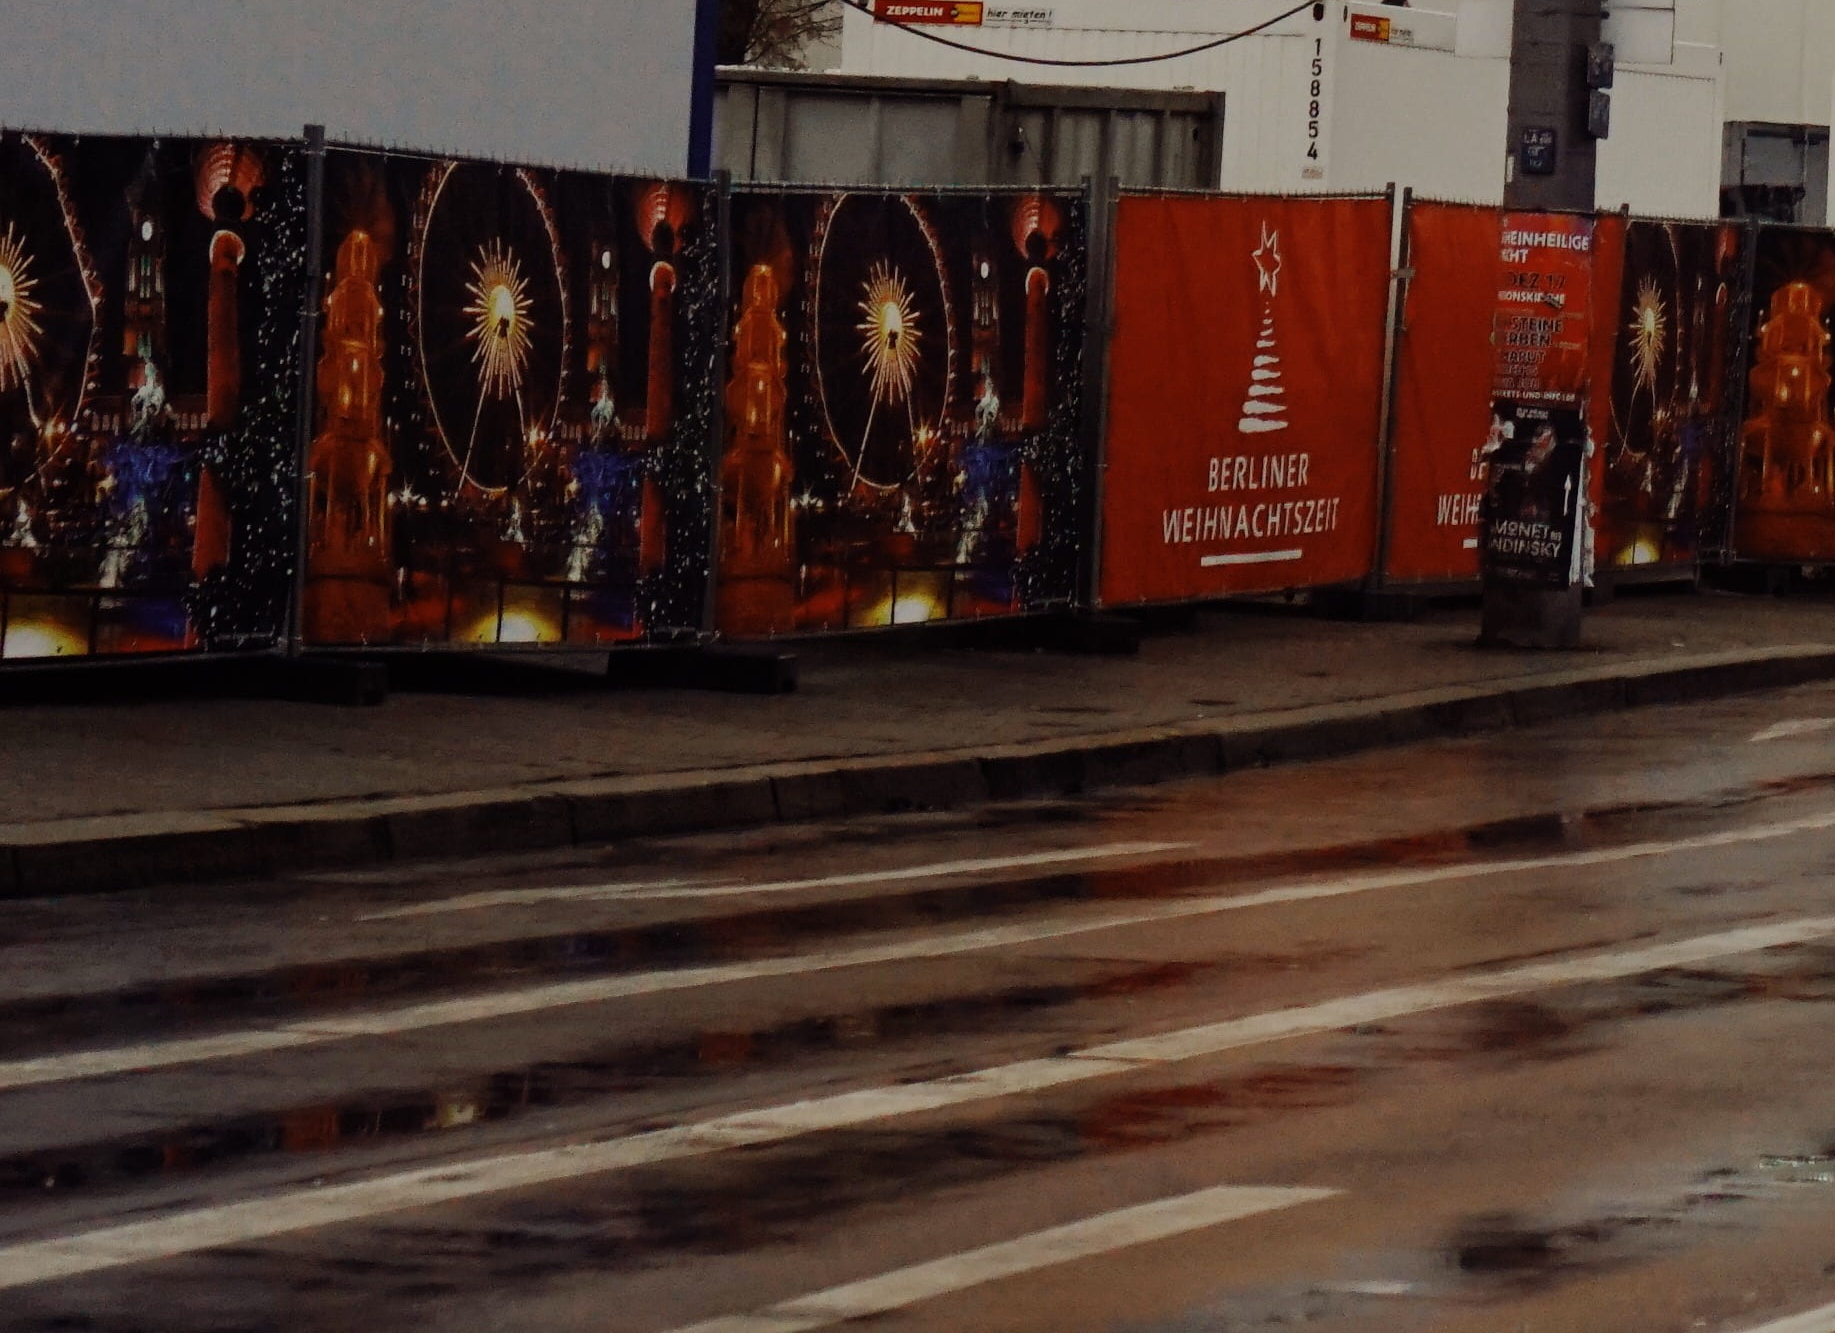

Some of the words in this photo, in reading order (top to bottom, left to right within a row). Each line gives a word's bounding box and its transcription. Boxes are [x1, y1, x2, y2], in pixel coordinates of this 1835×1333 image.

[886, 5, 944, 17] ZEPPELIN
[1306, 38, 1322, 160] 158854
[1208, 453, 1309, 492] BERLINER
[1162, 497, 1340, 544] WEIHNACHTSZEIT
